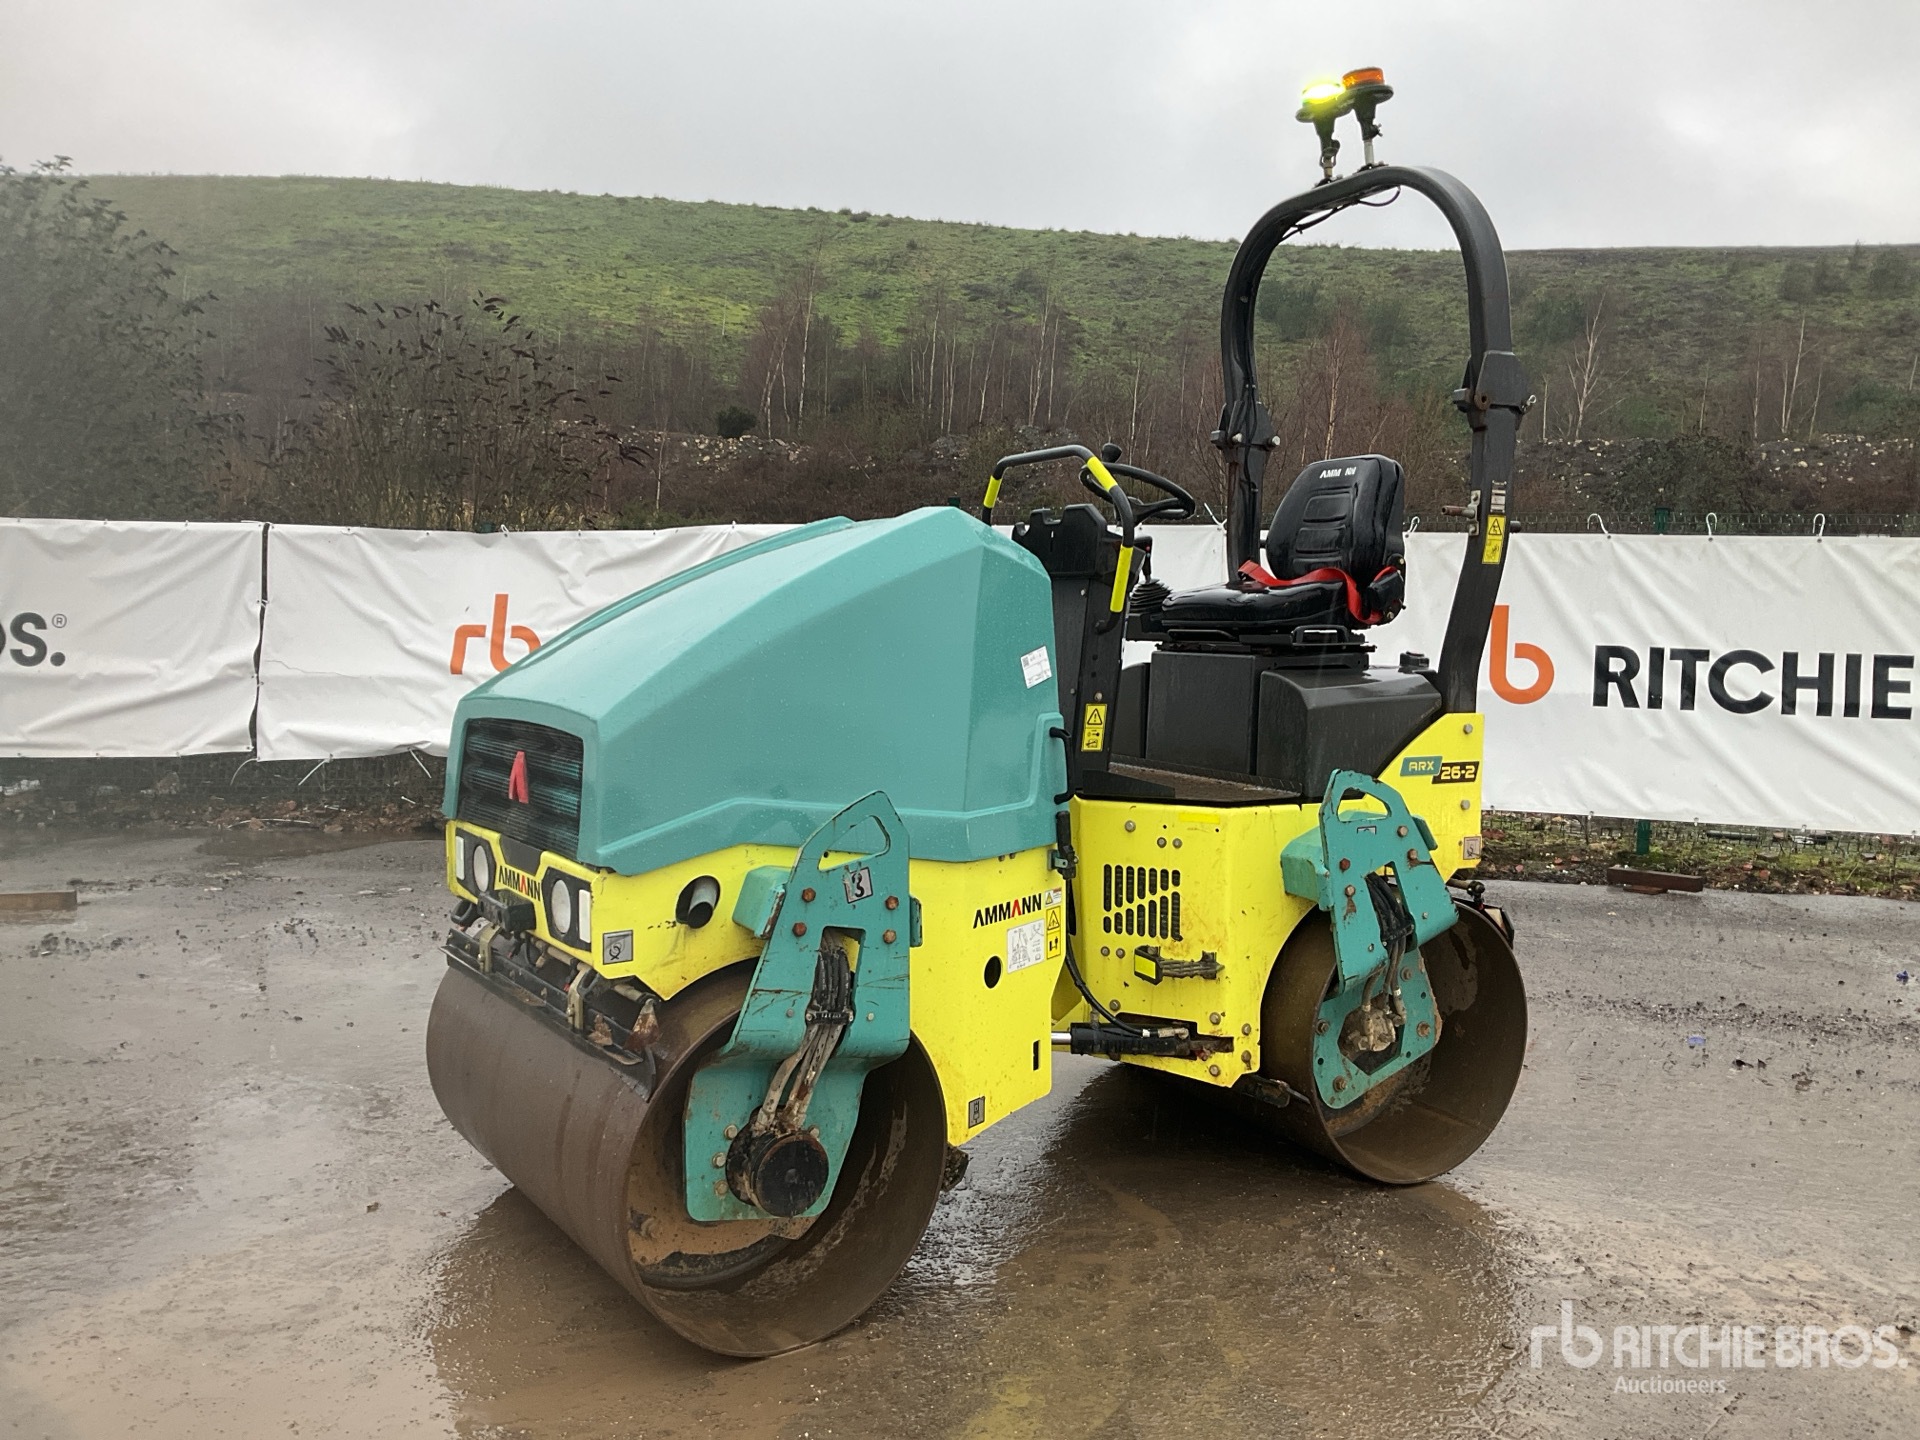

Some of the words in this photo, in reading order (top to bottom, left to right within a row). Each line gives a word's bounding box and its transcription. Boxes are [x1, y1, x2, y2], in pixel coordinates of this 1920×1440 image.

[0, 612, 66, 667] S.
[450, 593, 542, 675] rb
[1489, 605, 1555, 705] b
[1592, 645, 1914, 720] RITCHIE
[1408, 761, 1435, 772] ARX
[1440, 765, 1476, 780] 26-2
[498, 865, 541, 902] AMMANN
[972, 892, 1042, 929] AMMANN
